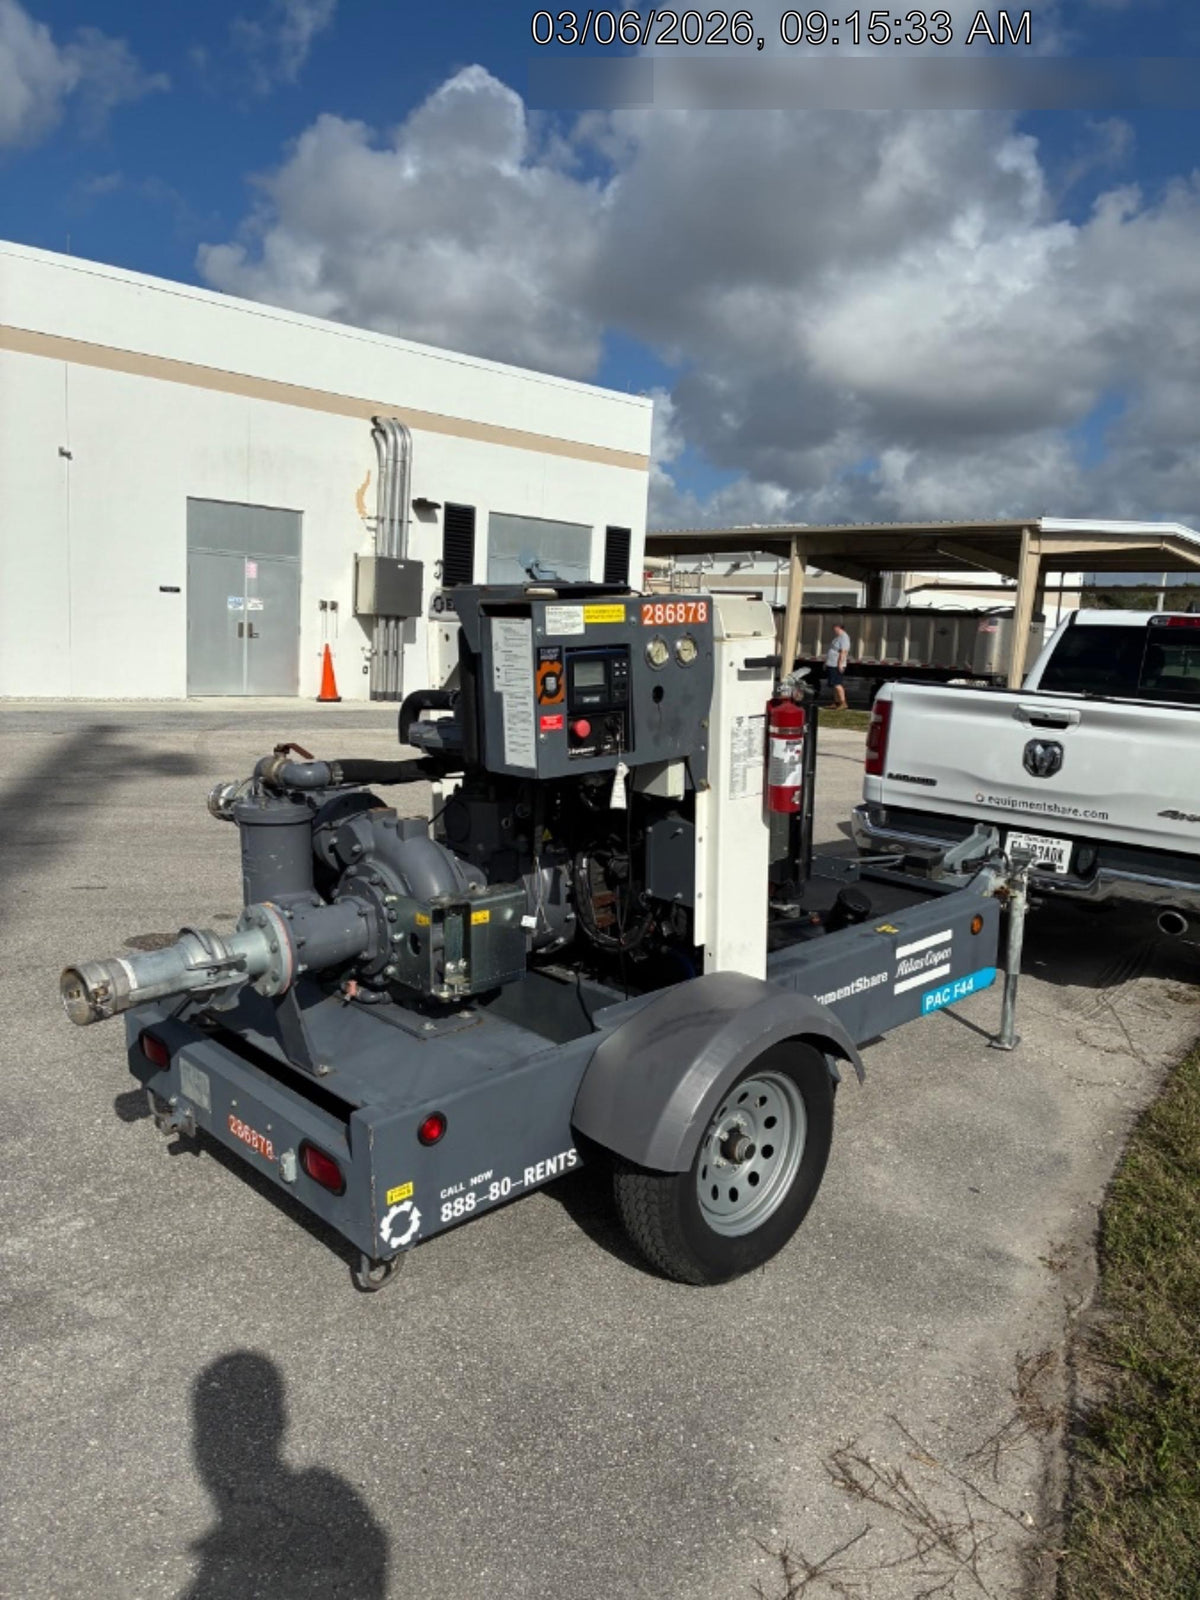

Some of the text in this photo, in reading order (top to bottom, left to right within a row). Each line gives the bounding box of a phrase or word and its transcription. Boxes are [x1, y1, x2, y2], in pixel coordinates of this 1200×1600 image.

[643, 602, 707, 625] 286878
[987, 793, 1109, 821] equipmentshare.com
[895, 946, 952, 979] Atlas Copco
[925, 977, 975, 1011] PAC F44
[440, 1169, 494, 1200] CALL NOW
